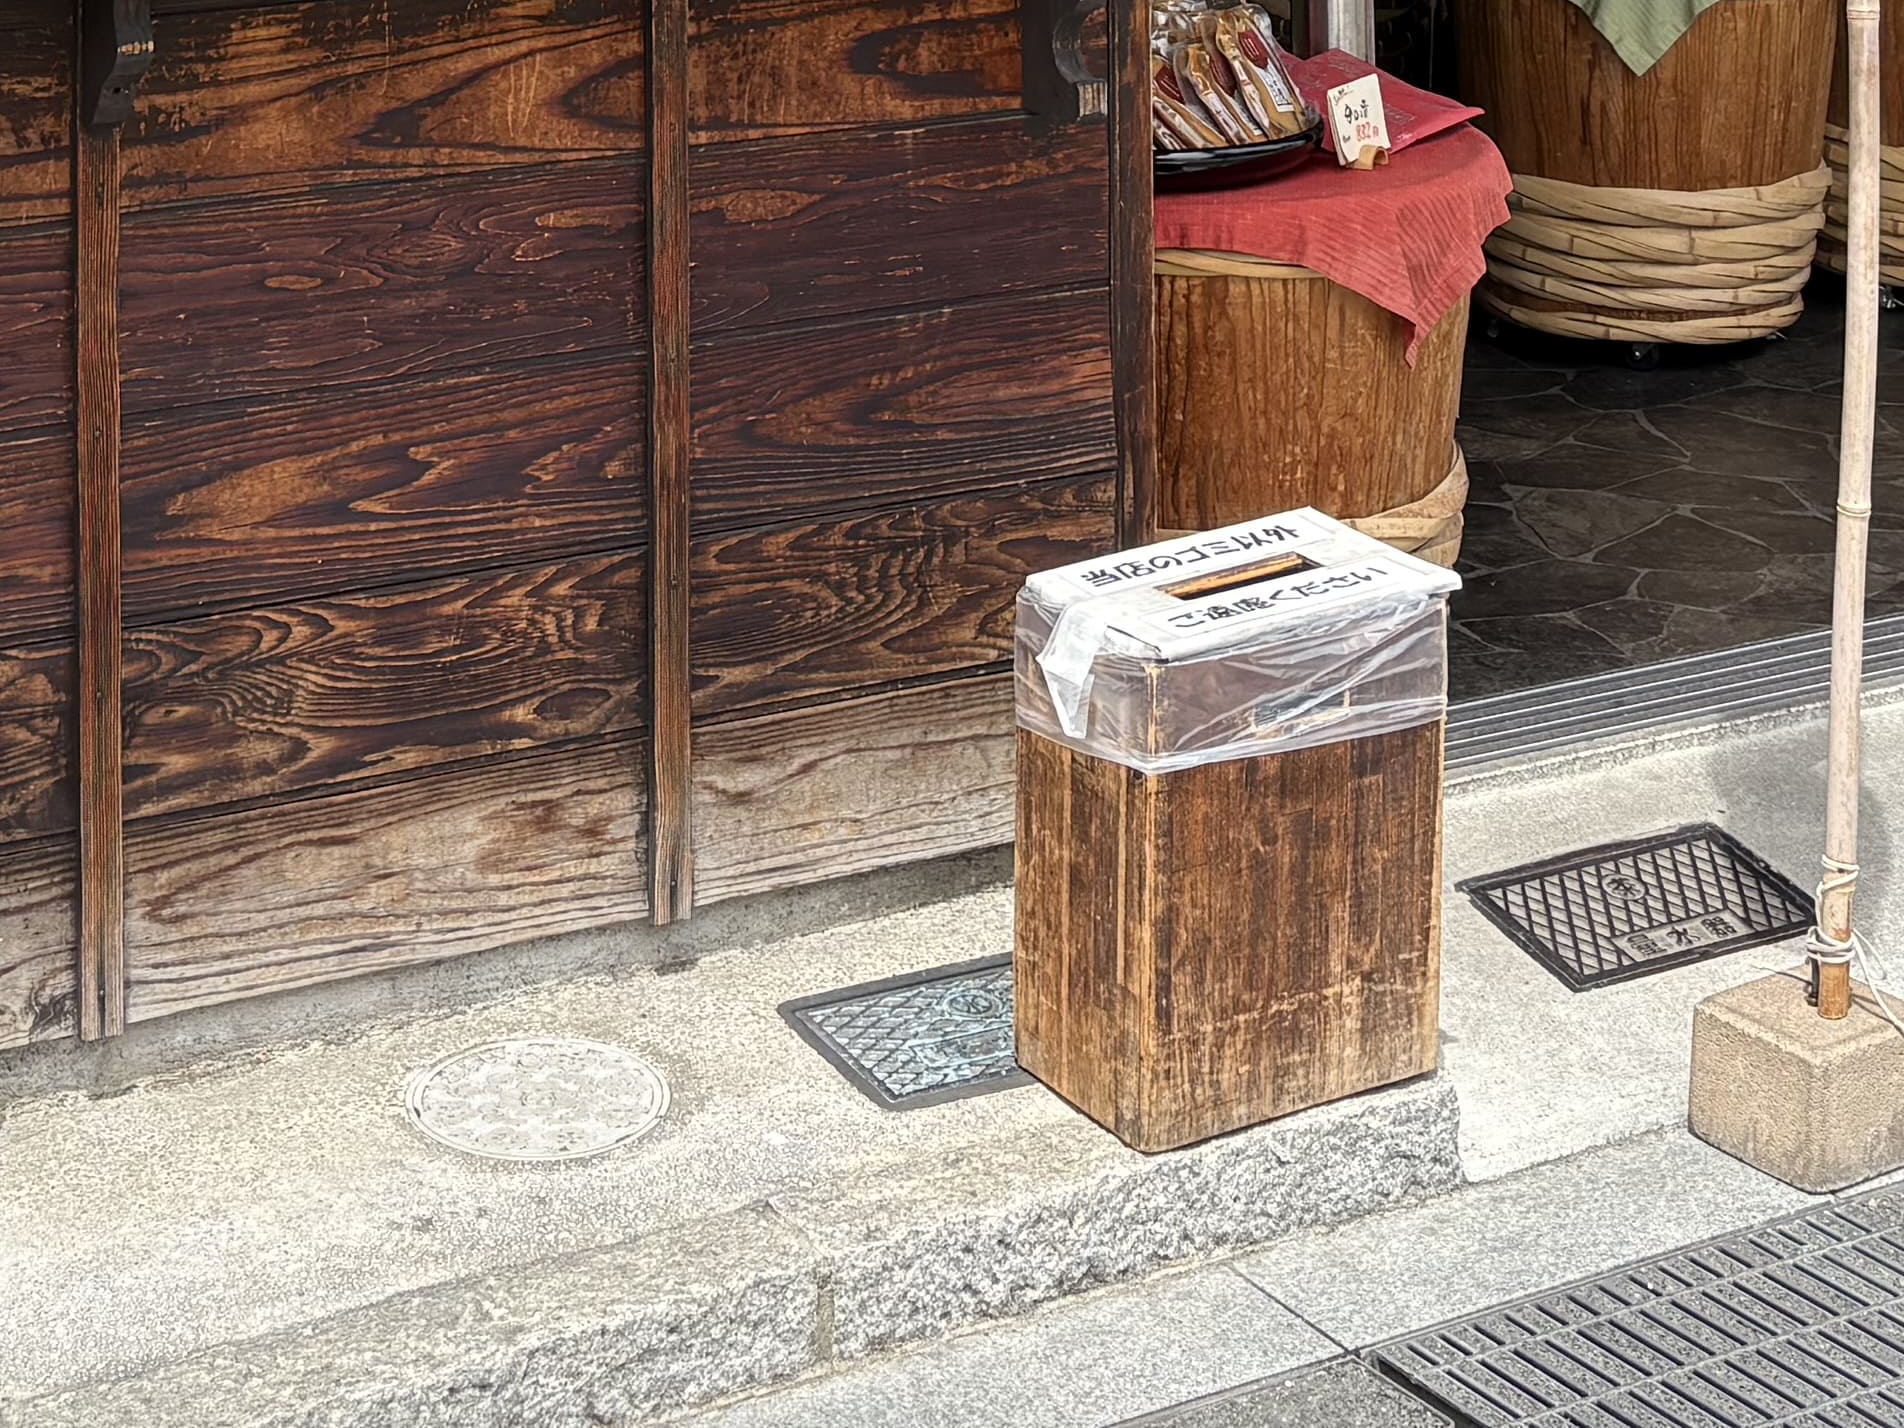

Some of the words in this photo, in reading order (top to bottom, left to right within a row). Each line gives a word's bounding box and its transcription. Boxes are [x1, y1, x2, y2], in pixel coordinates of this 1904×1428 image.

[1079, 521, 1302, 588] 当店のゴミ以外
[1167, 565, 1390, 631] ご遠慮ください
